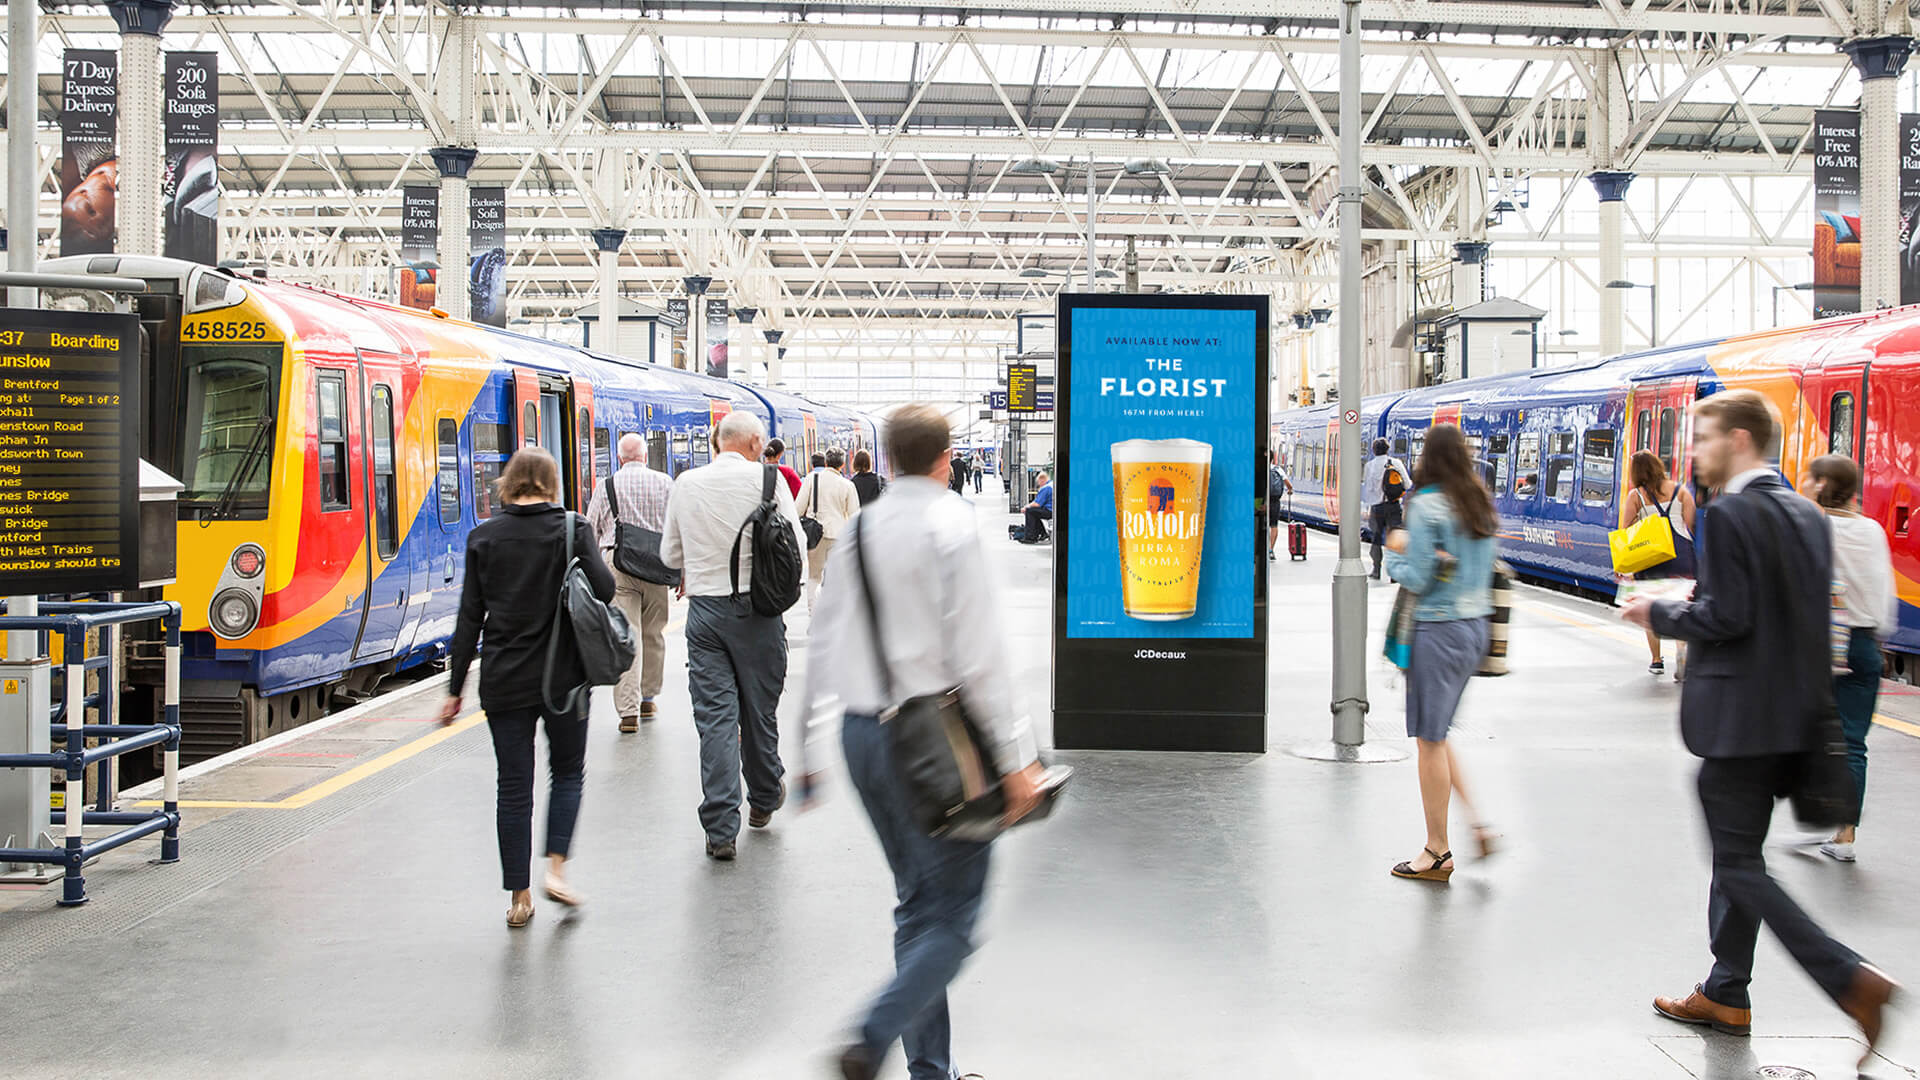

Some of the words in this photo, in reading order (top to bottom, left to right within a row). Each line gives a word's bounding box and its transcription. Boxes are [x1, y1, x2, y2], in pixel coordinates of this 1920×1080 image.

[67, 61, 79, 78] 7
[81, 61, 115, 84] Day
[176, 68, 207, 84] 200
[66, 80, 116, 99] Express
[177, 84, 207, 100] Sofa
[65, 98, 116, 116] Delivery
[168, 99, 216, 118] Ranges
[1818, 124, 1857, 138] Interest
[1824, 138, 1851, 152] Free
[1816, 154, 1835, 168] 0%
[1836, 156, 1858, 168] APR
[406, 196, 436, 206] Interest
[471, 198, 504, 208] Exclusive
[410, 206, 432, 218] Free
[477, 208, 499, 219] Sofa
[418, 220, 436, 228] APR
[471, 220, 505, 232] Designs
[184, 322, 266, 339] 458525
[50, 332, 120, 351] Boarding
[1105, 336, 1168, 346] AVAILABLE
[1172, 338, 1200, 346] NOW
[1204, 338, 1222, 346] AT:
[1146, 358, 1183, 371] THE
[4, 378, 60, 390] Brentford
[1100, 377, 1227, 398] FLORIST
[60, 394, 85, 406] Page
[88, 395, 94, 404] 1
[97, 395, 110, 404] of
[112, 395, 120, 404] 2
[992, 394, 1006, 407] 15
[1148, 408, 1175, 416] FROM
[54, 421, 84, 431] Road
[33, 434, 48, 445] Jn
[54, 449, 84, 458] Town
[26, 490, 70, 502] Bridge
[6, 518, 48, 530] Bridge
[18, 546, 47, 556] West
[52, 544, 94, 554] Trains
[55, 558, 96, 568] should
[102, 557, 120, 566] tra
[1134, 649, 1186, 659] JCDecaux
